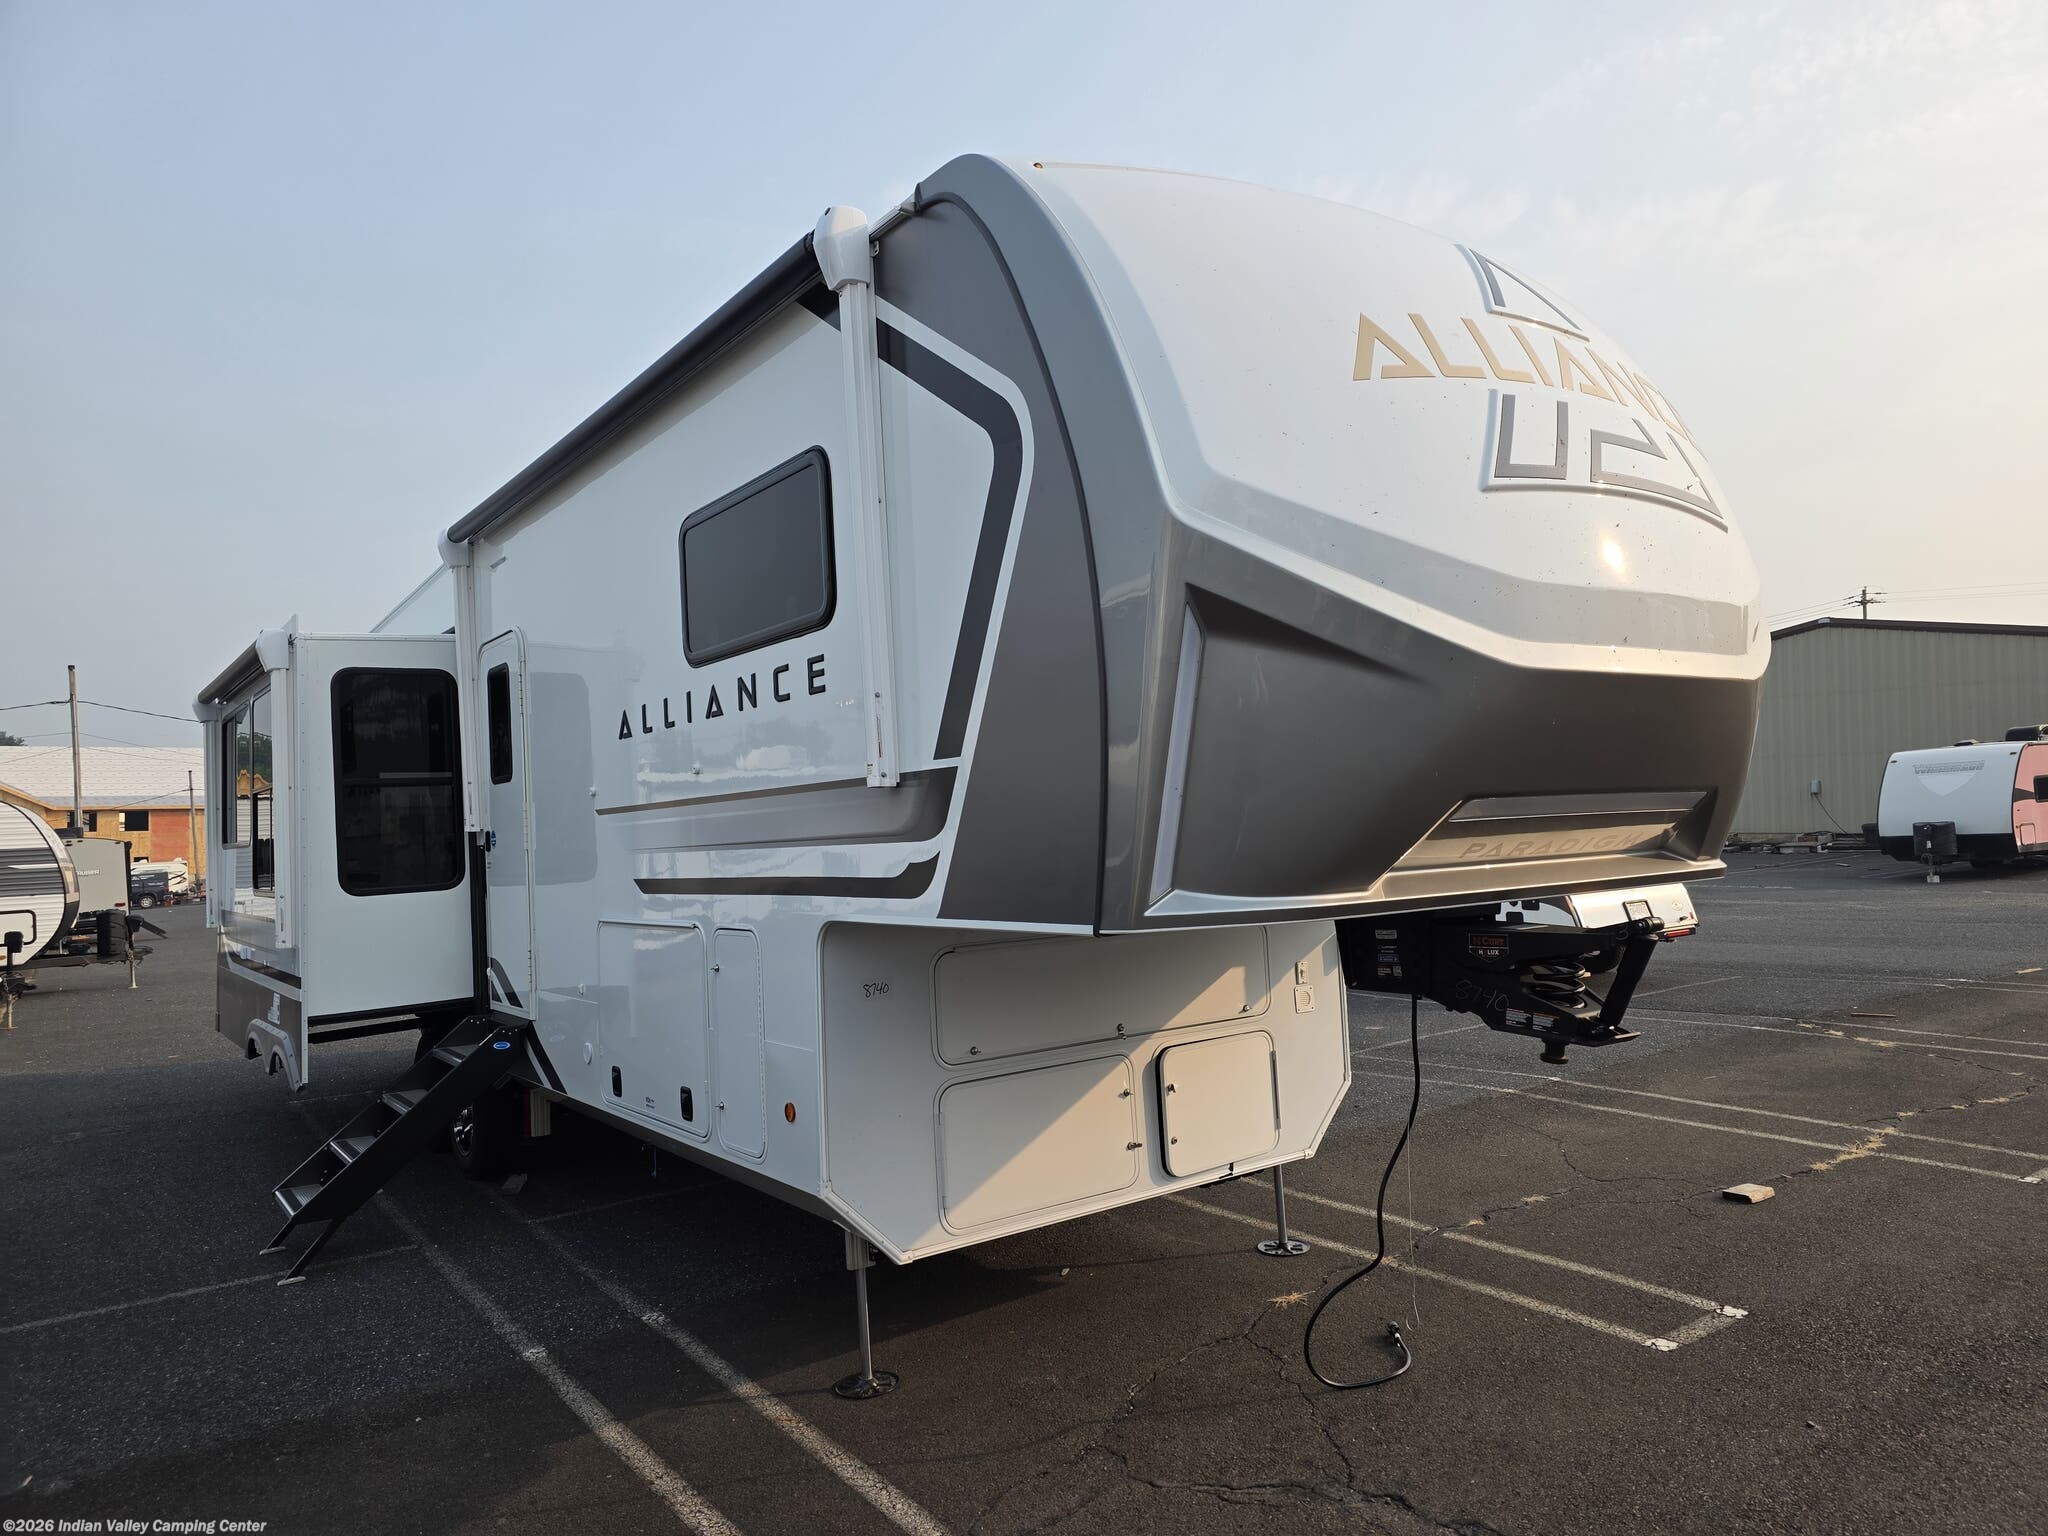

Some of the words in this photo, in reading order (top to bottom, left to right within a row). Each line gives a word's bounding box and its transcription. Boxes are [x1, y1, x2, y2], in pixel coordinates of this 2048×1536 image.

[618, 653, 826, 740] ALLIANCE
[1459, 832, 1643, 859] PARADIGM
[863, 982, 890, 998] 8740
